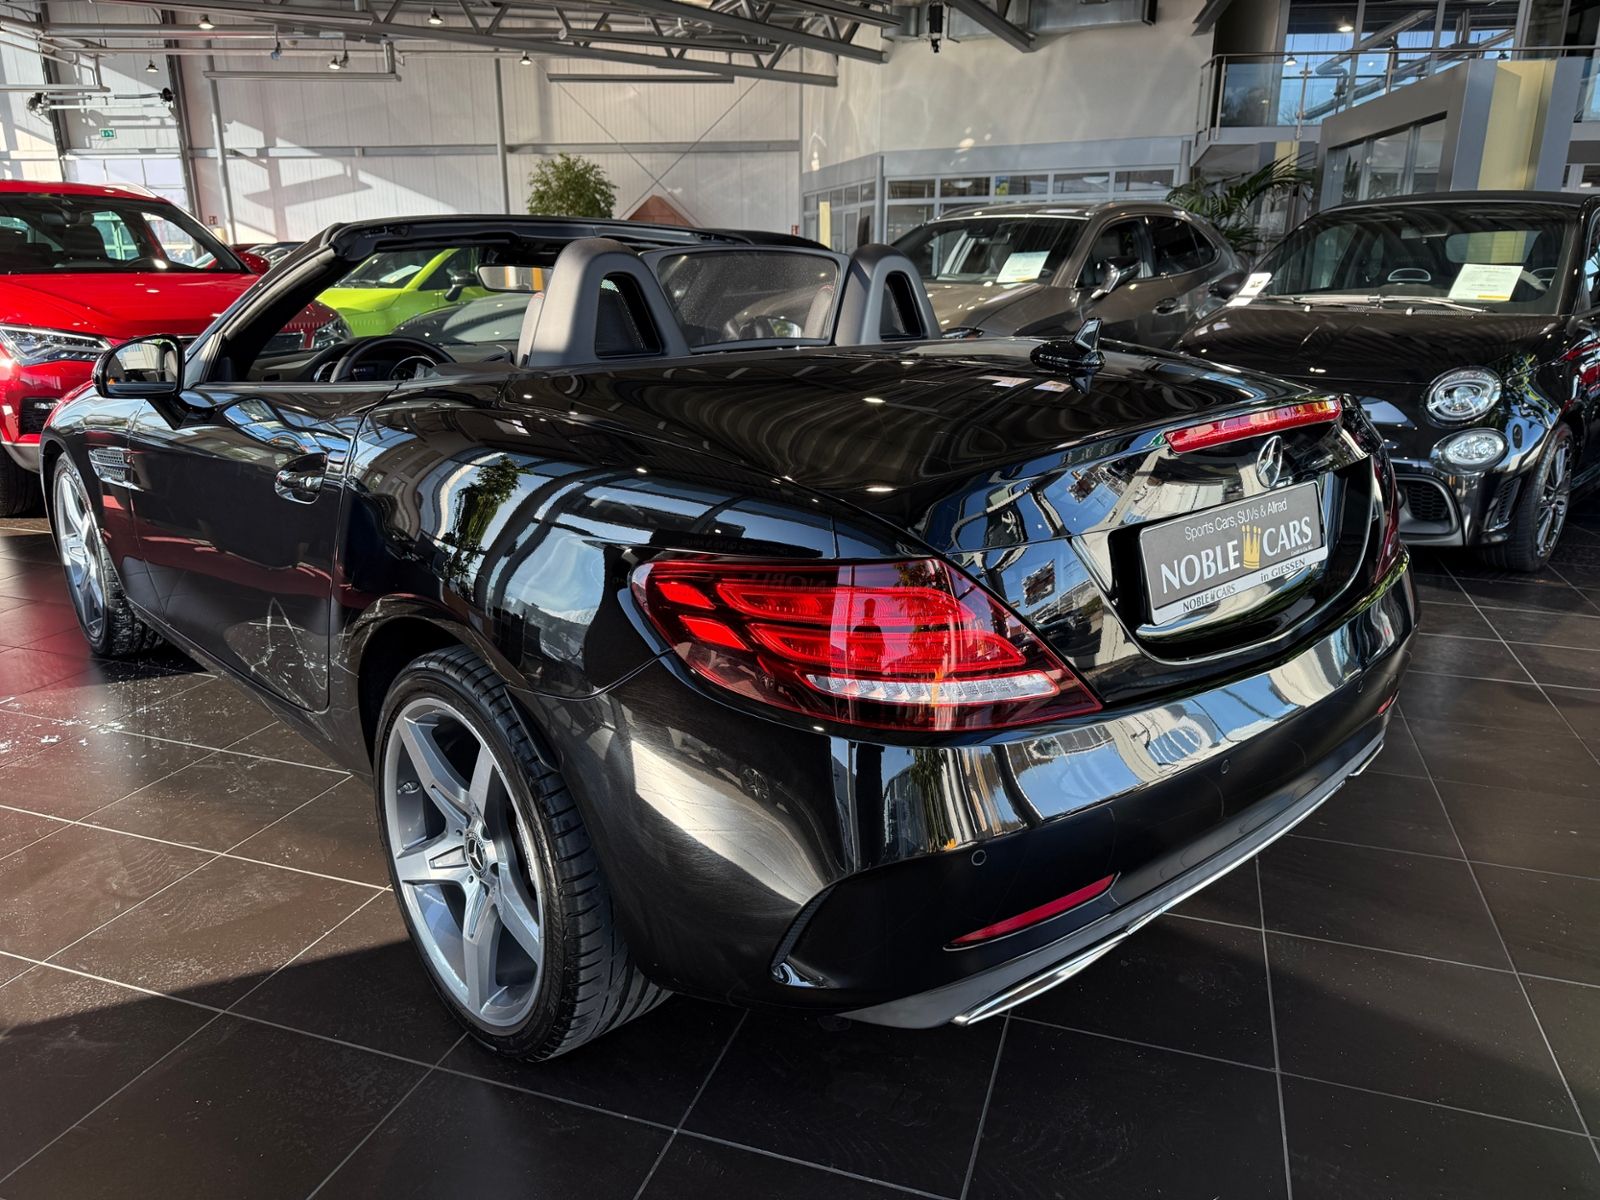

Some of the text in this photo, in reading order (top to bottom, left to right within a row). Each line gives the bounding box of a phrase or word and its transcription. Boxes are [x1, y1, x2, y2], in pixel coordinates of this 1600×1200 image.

[1184, 498, 1288, 542] Sports Cars, SUVs & Allrad
[1160, 516, 1312, 594] NOBLE CARS
[1182, 557, 1306, 612] NOBLE CARS in GIESSEN
